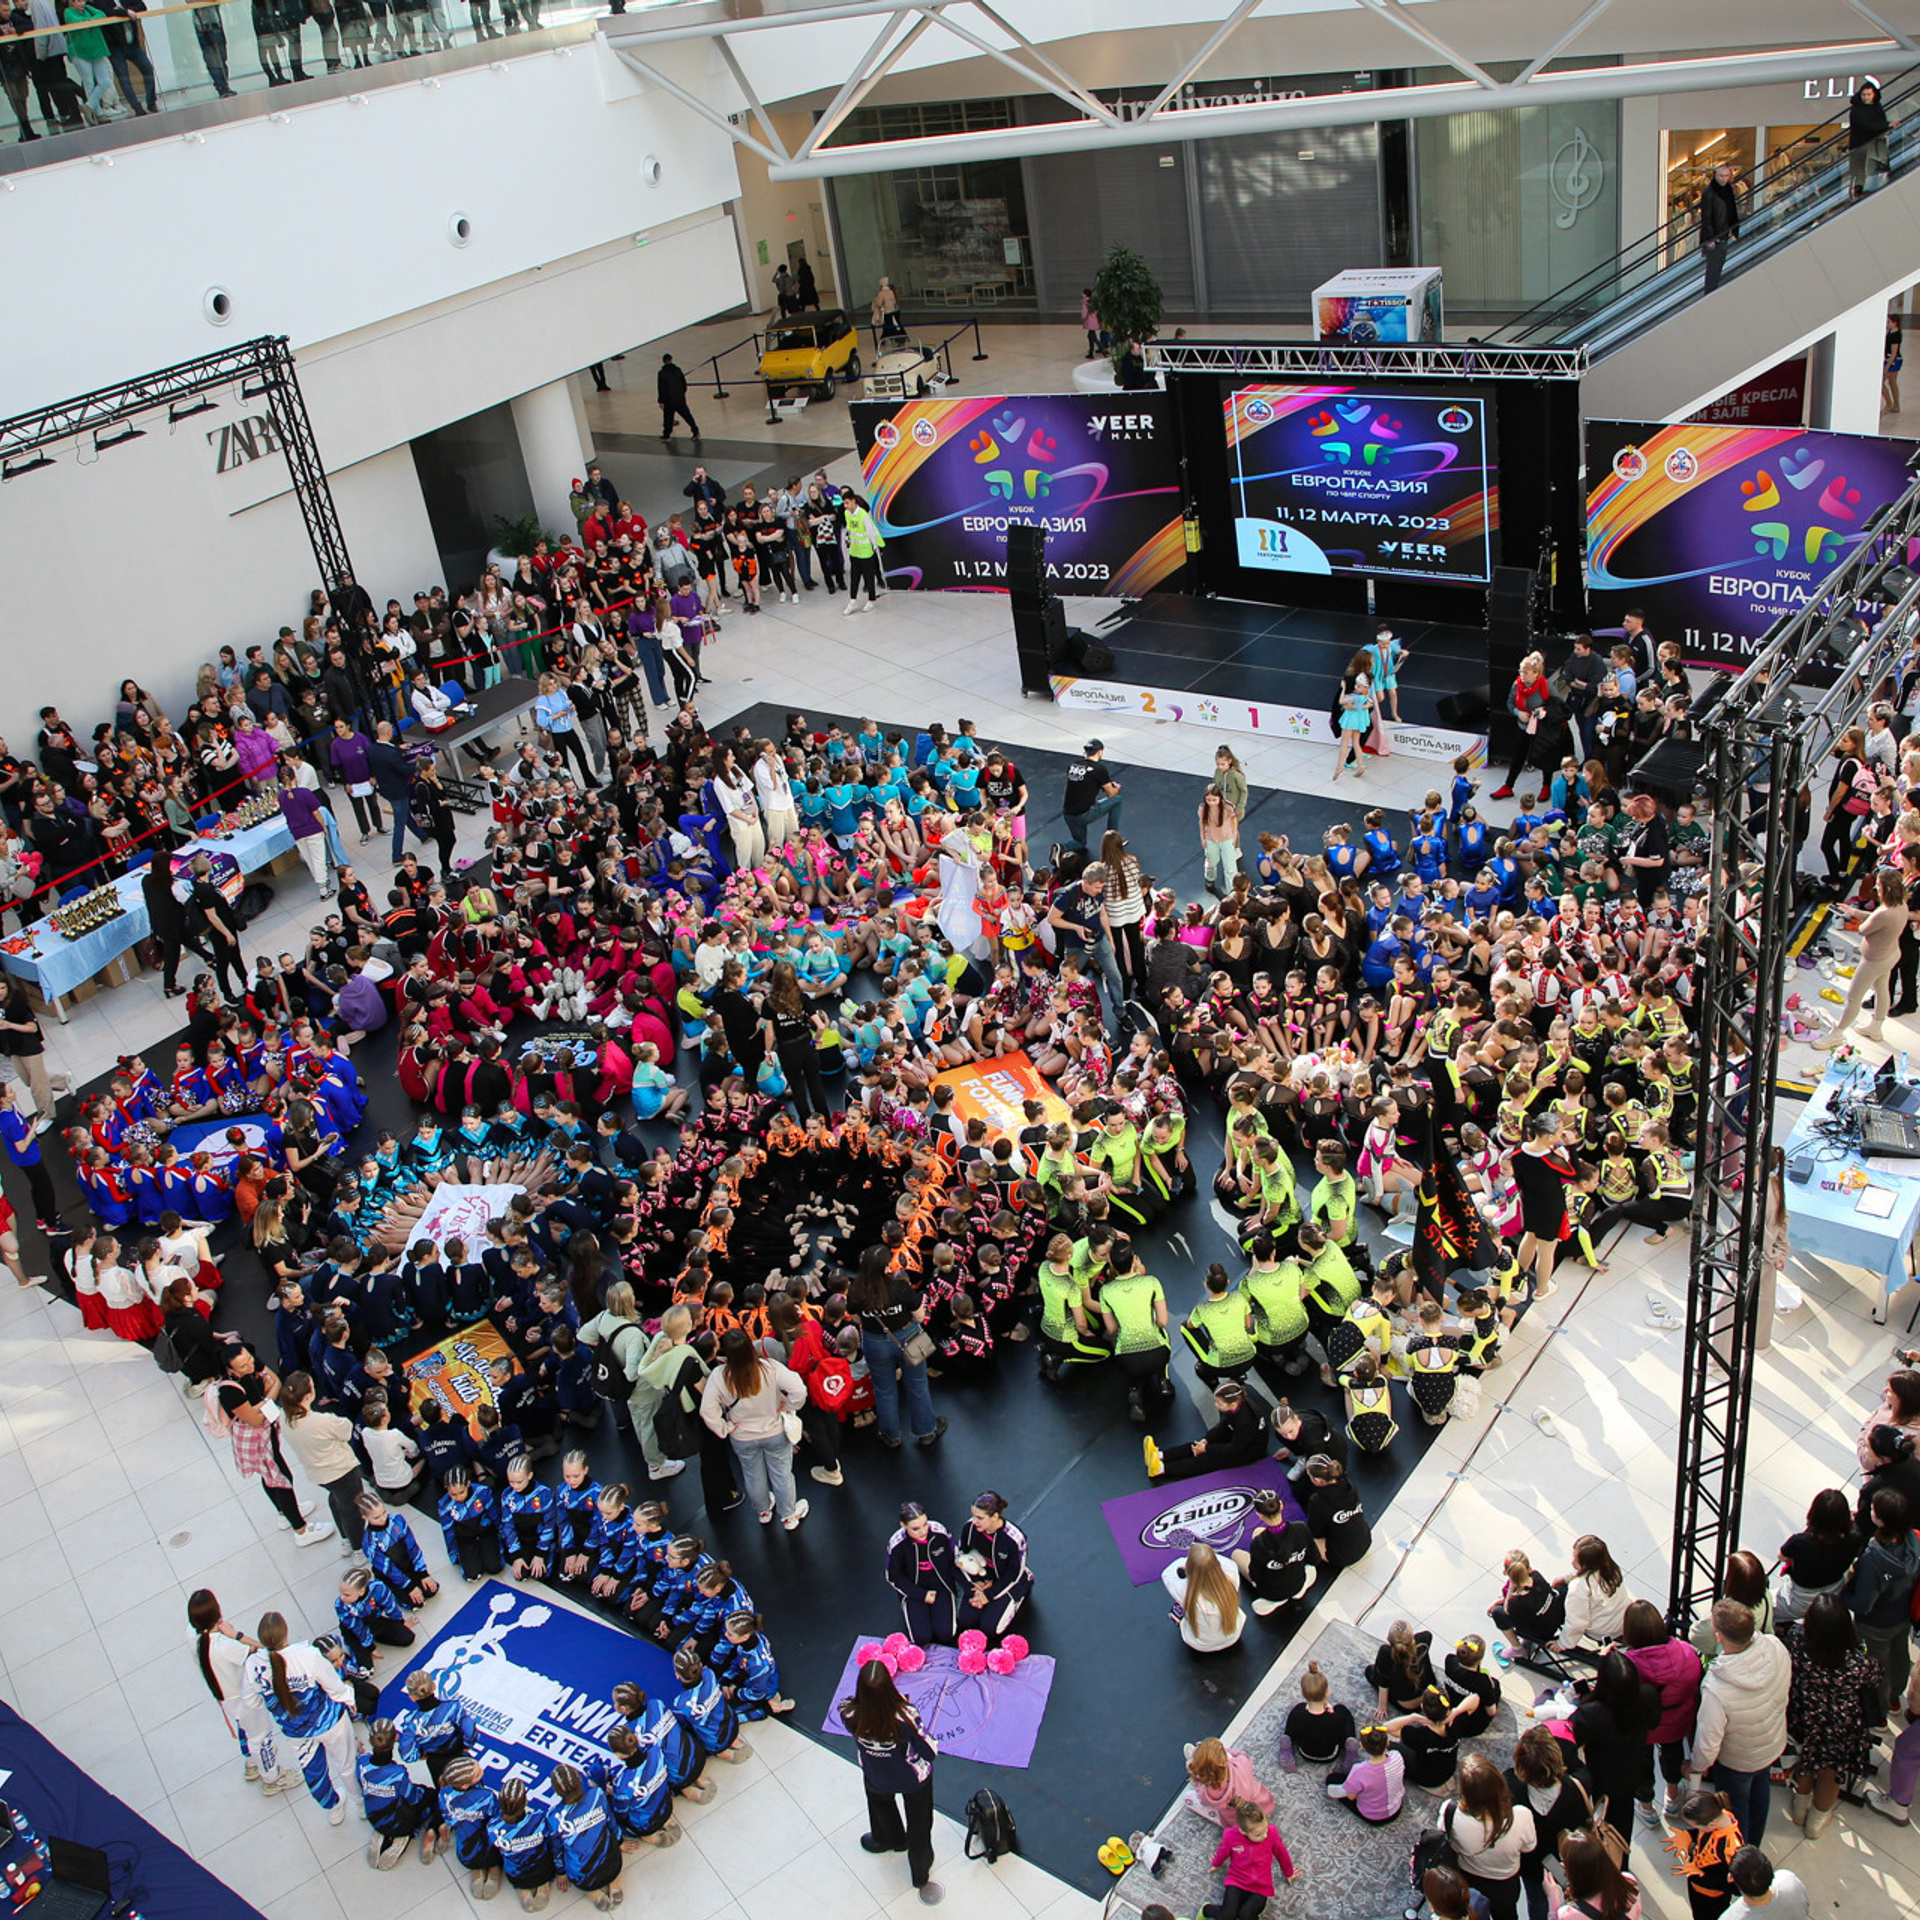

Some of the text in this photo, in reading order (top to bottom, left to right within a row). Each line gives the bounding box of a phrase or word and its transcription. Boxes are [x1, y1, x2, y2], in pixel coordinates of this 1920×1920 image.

[1803, 75, 1881, 99] ELI
[1742, 387, 1798, 405] КРЕСЛА
[1091, 414, 1155, 431] VEER
[1111, 432, 1154, 440] MALL
[1343, 469, 1372, 477] КУБОК
[1291, 474, 1428, 494] ЕВРОПА-АЗИЯ
[1326, 490, 1339, 498] ПО
[1358, 491, 1391, 500] СПОРТУ
[1008, 505, 1035, 514] КУБОК
[1276, 507, 1451, 531] 11, 12 МАРТА 2023
[1383, 540, 1448, 556] VEER
[953, 561, 972, 578] 11,
[974, 562, 992, 577] 12
[1063, 563, 1110, 580] 2023
[1776, 569, 1811, 581] КУБОК
[1750, 603, 1765, 613] ПО
[1767, 605, 1788, 616] ЧИР
[1684, 628, 1734, 651] 11, 12
[1140, 692, 1157, 713] 2
[1248, 707, 1259, 728] 1
[449, 1371, 484, 1404] kids
